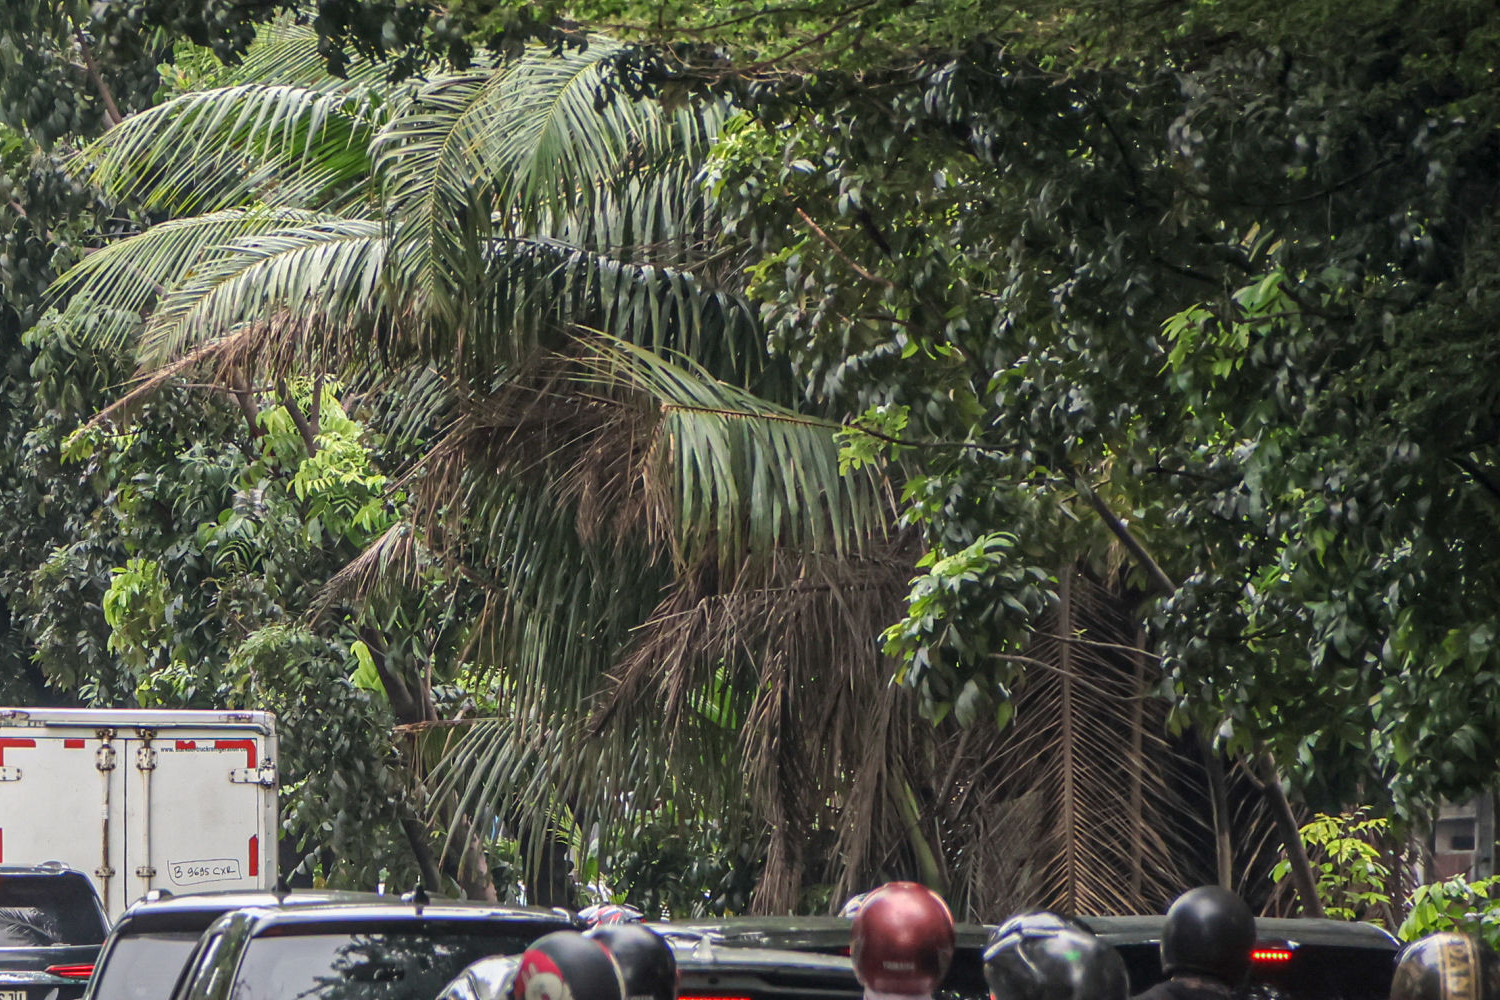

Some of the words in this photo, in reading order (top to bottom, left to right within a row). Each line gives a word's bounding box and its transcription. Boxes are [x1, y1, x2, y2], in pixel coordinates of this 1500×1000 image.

[174, 866, 183, 878] B
[188, 867, 210, 877] 9695
[213, 866, 236, 875] CXR
